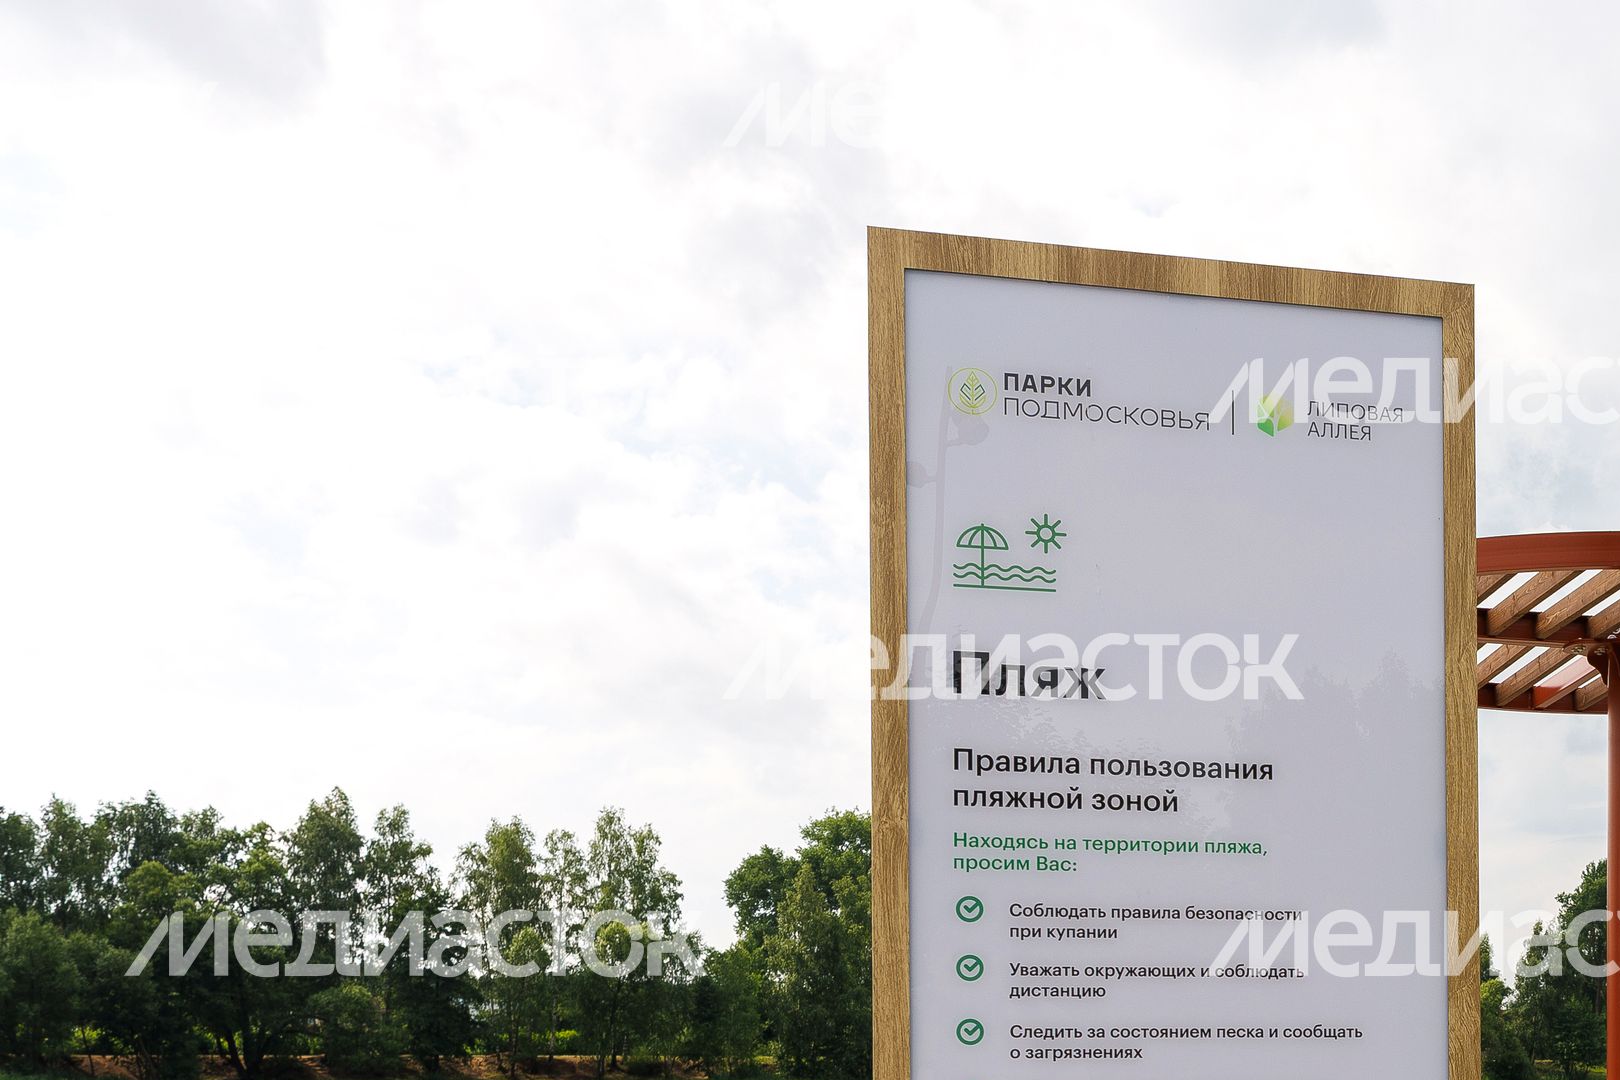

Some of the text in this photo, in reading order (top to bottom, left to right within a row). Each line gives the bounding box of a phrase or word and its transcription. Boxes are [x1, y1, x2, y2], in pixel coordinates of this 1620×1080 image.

[1003, 372, 1092, 398] ПАРКИ
[1003, 396, 1210, 432] ПОДМОСКОВЬЯ
[1307, 400, 1404, 420] ЛИПОВАЯ
[1307, 421, 1372, 442] АЛЛЕЯ
[952, 650, 1106, 700] Пляж
[953, 747, 1273, 781] Правила пользования
[953, 786, 1178, 813] пляжной зоной
[953, 831, 1268, 857] Находясь на территории пляжа,
[953, 855, 1077, 873] просим Вас:
[1009, 902, 1302, 922] Соблюдать правила безопасности
[1009, 927, 1118, 942] при купании
[1008, 962, 1305, 981] Уважать окружающих и соблюдать
[1008, 986, 1107, 1000] дистанцию
[1009, 1023, 1363, 1041] Следить за состоянием песка и сообщать
[1009, 1048, 1144, 1062] о загрязнениях
